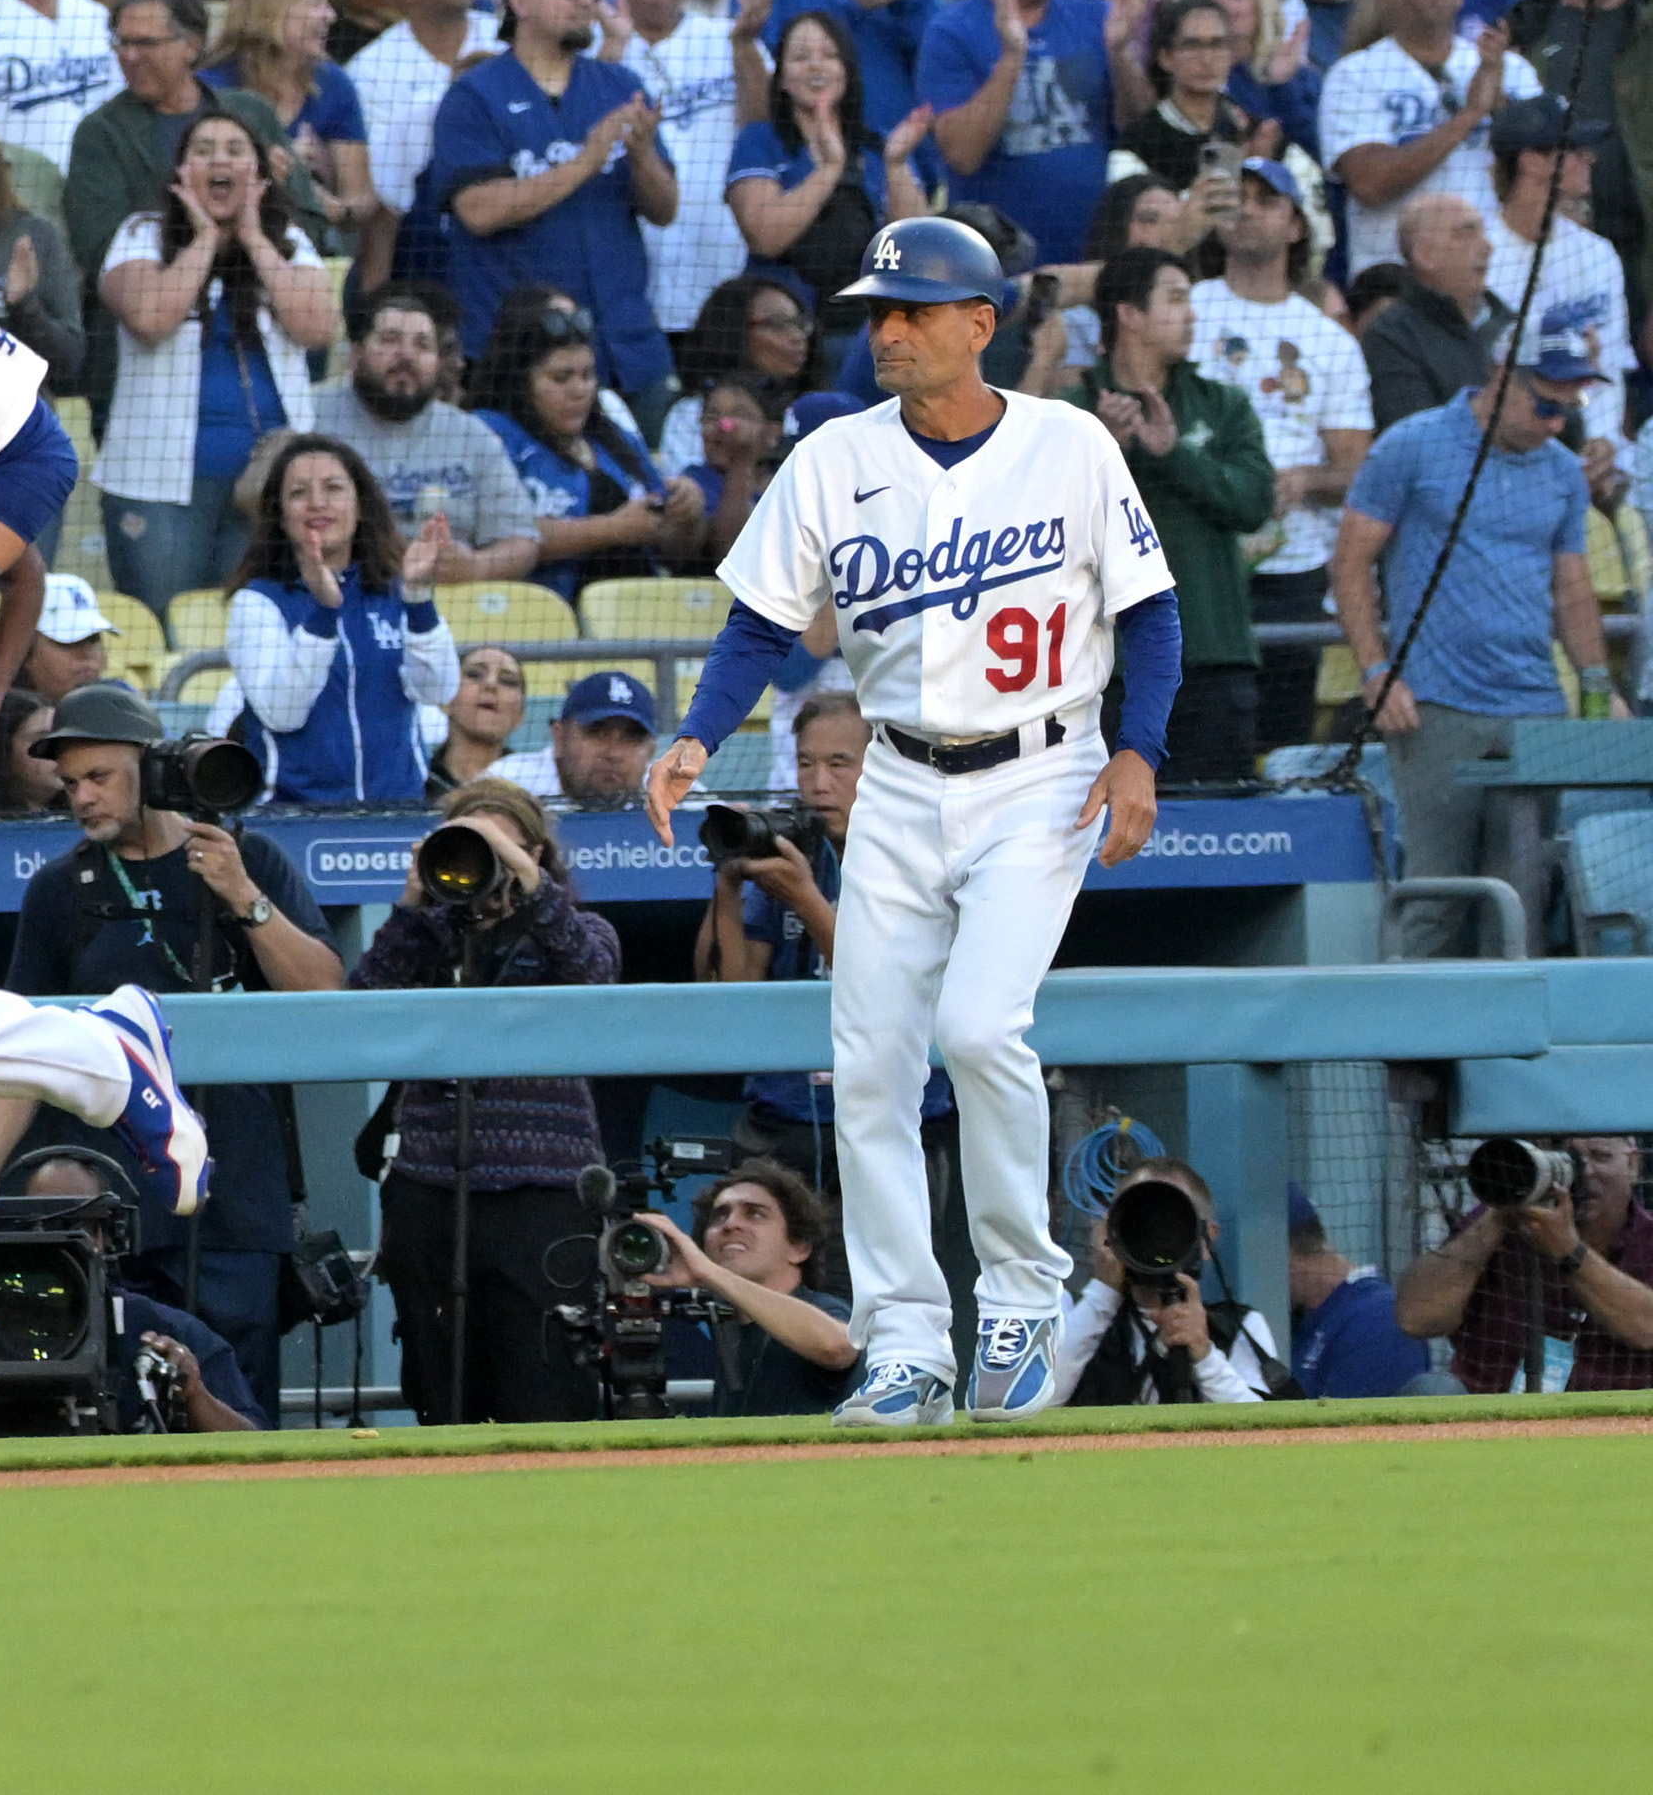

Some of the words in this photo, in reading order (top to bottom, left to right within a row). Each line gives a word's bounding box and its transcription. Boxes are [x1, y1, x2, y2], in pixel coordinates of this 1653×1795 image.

[873, 231, 901, 270] LA
[1121, 498, 1160, 557] LA
[830, 516, 1065, 620] Dodgers
[985, 603, 1066, 694] 91
